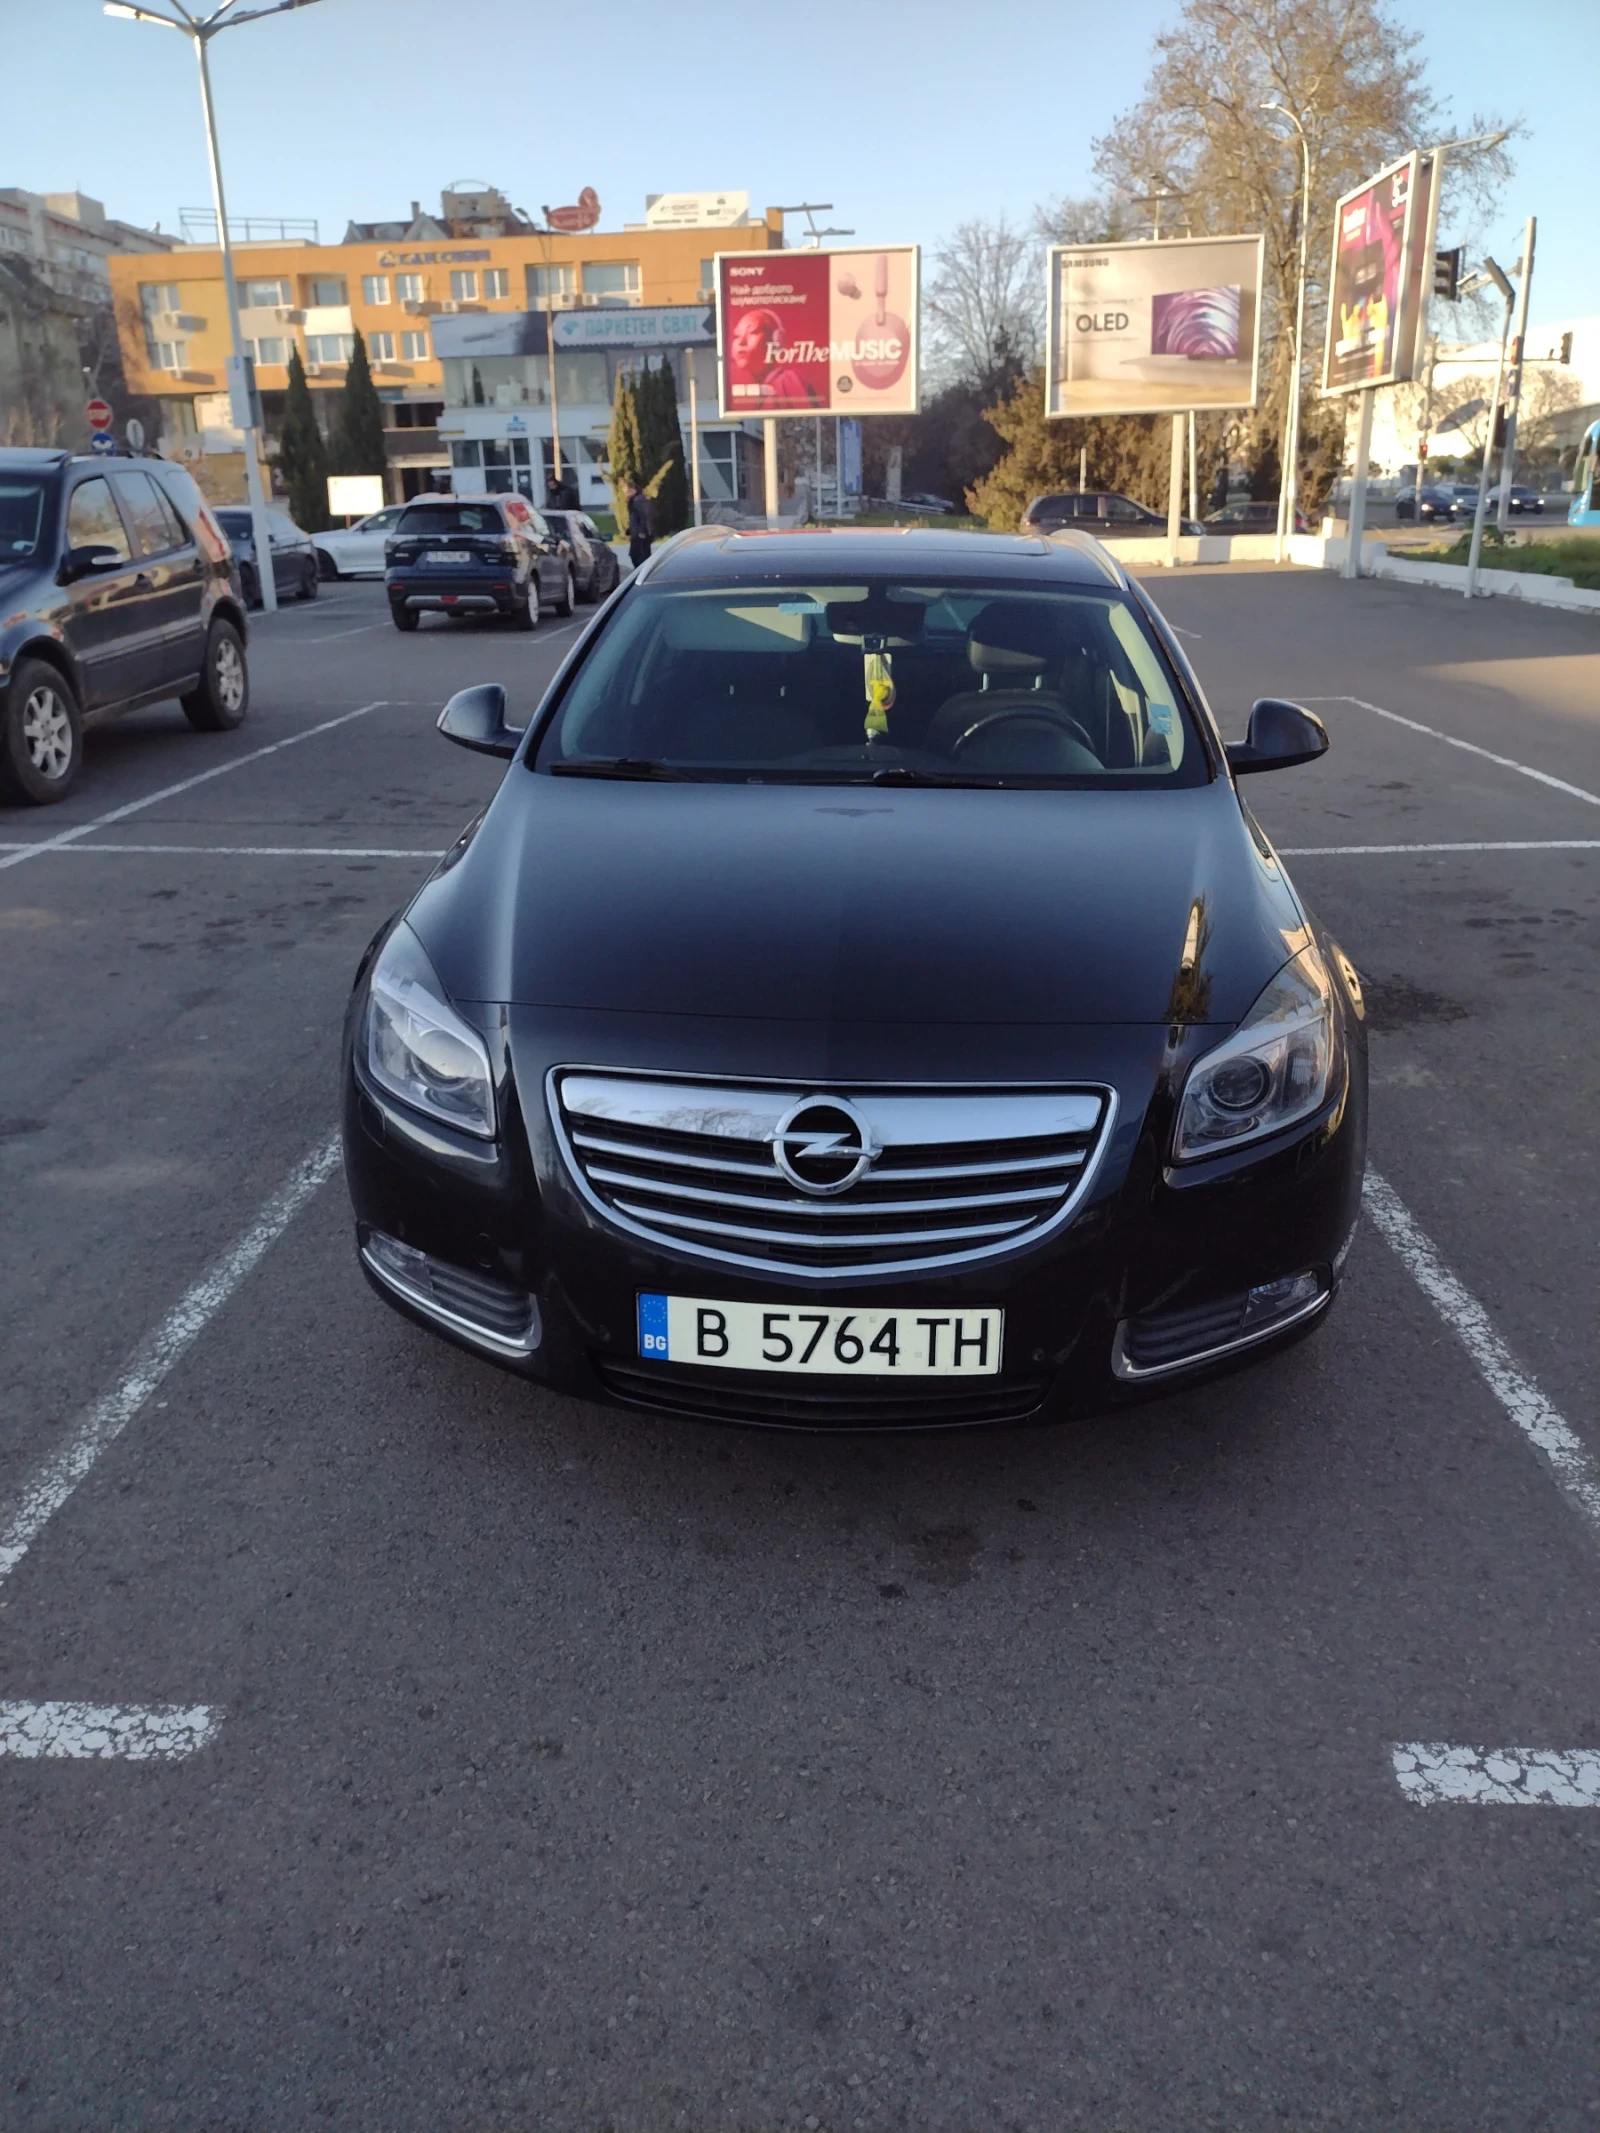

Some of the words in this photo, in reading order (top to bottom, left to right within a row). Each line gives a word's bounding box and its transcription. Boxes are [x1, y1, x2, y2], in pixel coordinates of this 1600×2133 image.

[730, 267, 765, 276] SONY
[1062, 258, 1109, 268] SAMSUNG
[584, 316, 657, 337] ПАРКЕТЕН
[662, 314, 698, 335] СВЯТ
[1076, 312, 1130, 333] OLED
[643, 1333, 667, 1352] BG
[696, 1307, 731, 1358] B
[761, 1313, 901, 1368] 5764
[916, 1317, 990, 1368] TH
